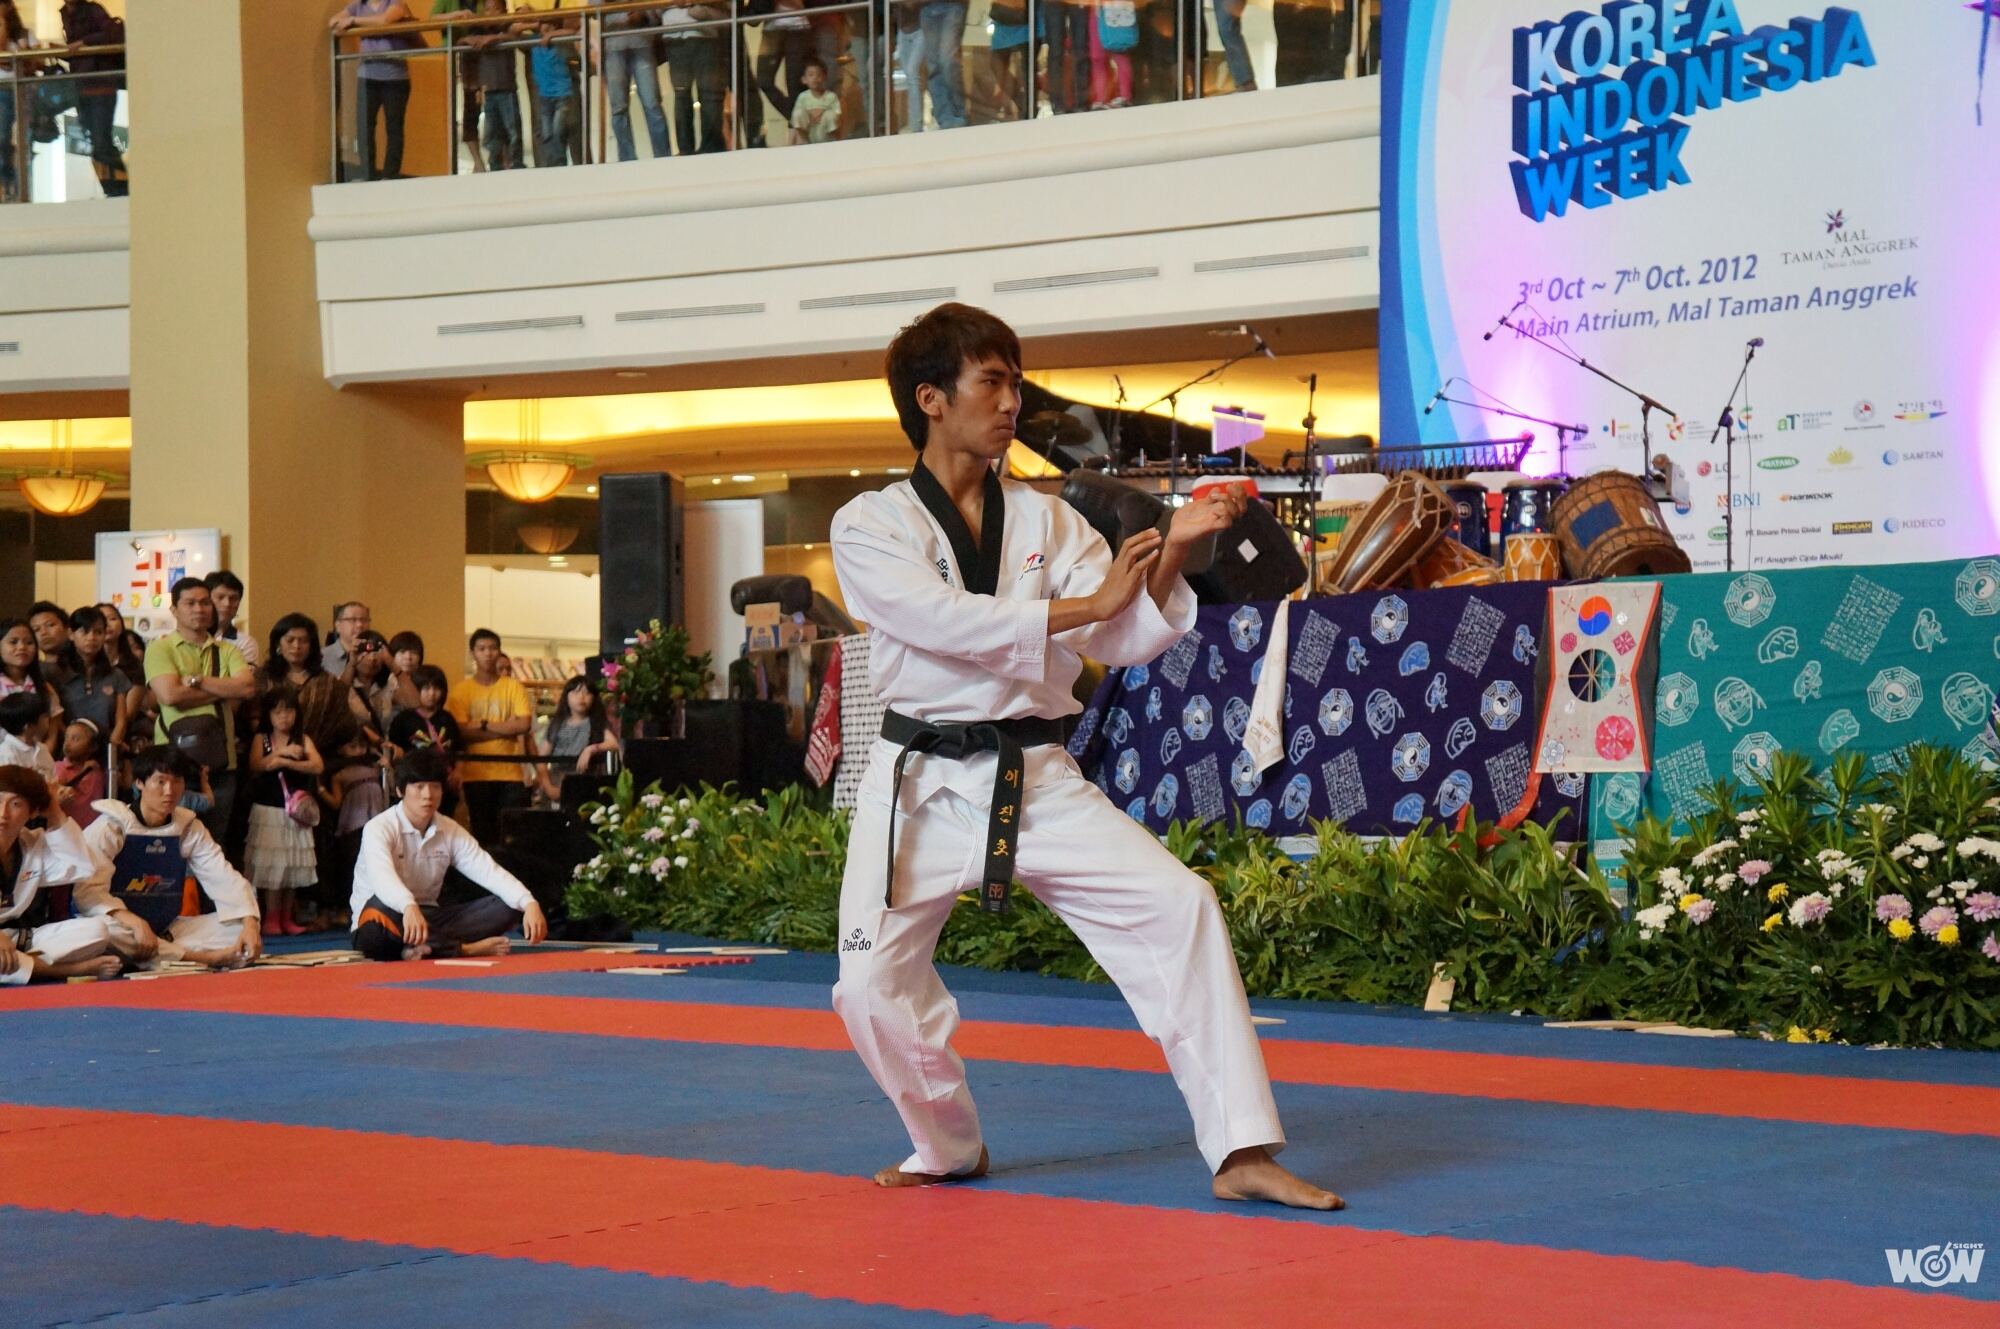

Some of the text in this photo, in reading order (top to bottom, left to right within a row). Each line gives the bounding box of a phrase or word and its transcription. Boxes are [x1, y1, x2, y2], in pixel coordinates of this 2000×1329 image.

[1512, 0, 1743, 92] KOREA
[1512, 7, 1877, 159] INDONESIA
[1508, 119, 1691, 222] WEEK
[1835, 229, 1869, 244] MAL
[1781, 237, 1919, 265] TAMAN ANGGREK
[1548, 277, 1585, 302] Oct
[1614, 267, 1640, 295] 7th
[1646, 264, 1690, 291] Oct.
[1698, 254, 1758, 285] 2012
[1515, 275, 1919, 339] Main Atrium, Mal Taman Anggrek
[1902, 450, 1944, 461] SAMTAN
[1733, 492, 1761, 507] BNI
[1902, 518, 1946, 529] KIDECO
[842, 937, 871, 951] Daedo
